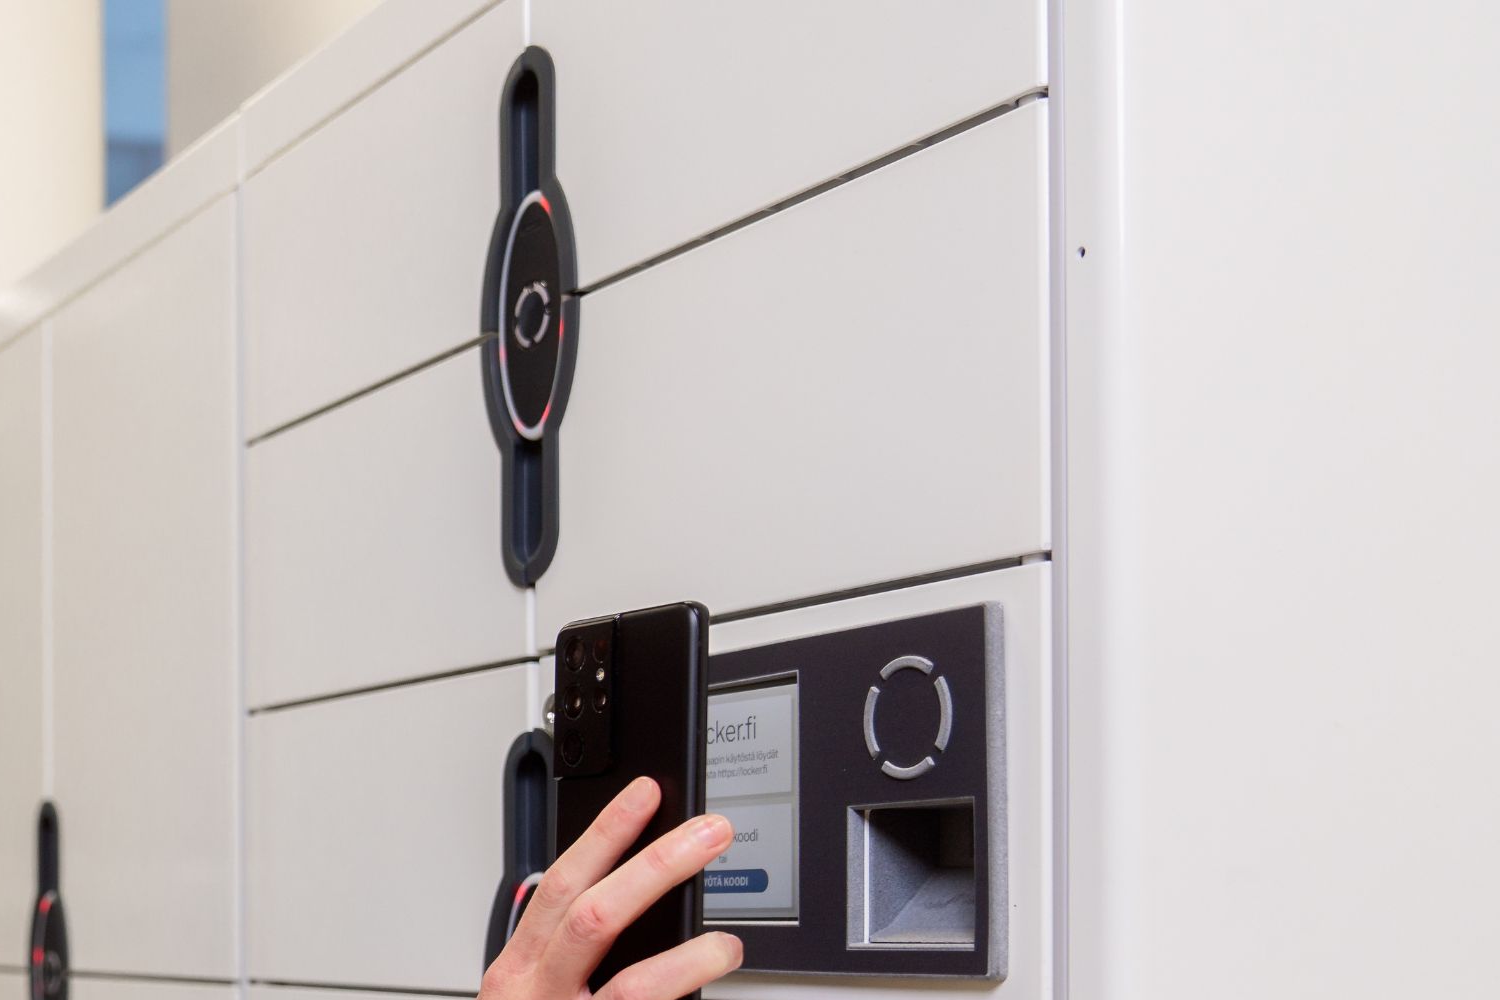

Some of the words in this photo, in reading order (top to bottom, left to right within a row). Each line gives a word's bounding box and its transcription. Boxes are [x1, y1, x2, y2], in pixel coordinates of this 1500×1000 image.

[707, 715, 756, 745] cker.fi
[704, 874, 722, 887] YÖTÄ
[723, 876, 749, 887] KOODI
